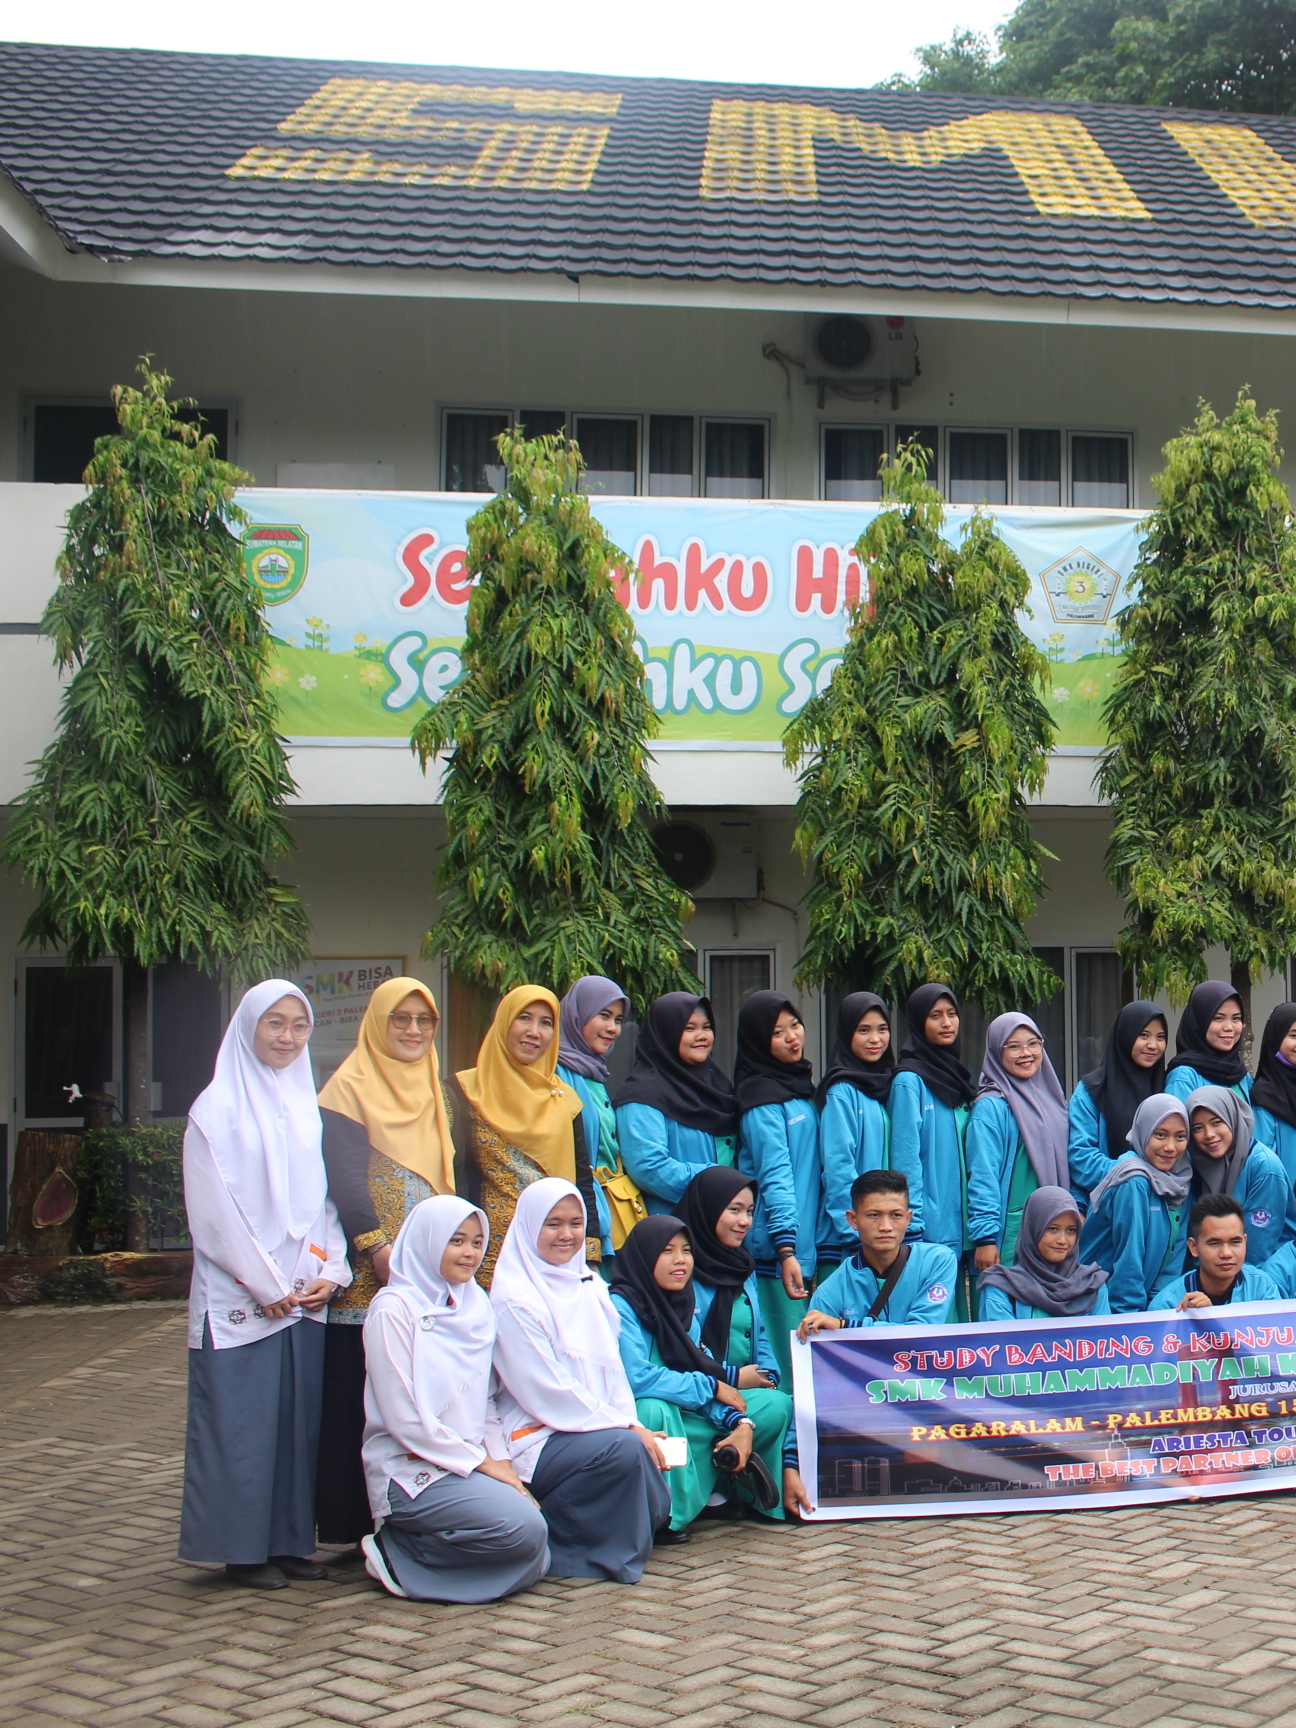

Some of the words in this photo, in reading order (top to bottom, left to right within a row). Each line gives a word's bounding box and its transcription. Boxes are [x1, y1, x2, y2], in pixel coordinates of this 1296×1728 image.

[888, 332, 903, 340] LG
[246, 540, 276, 549] SUMATERA
[277, 540, 302, 550] SELATAN
[399, 531, 769, 614] Sehku
[1058, 562, 1073, 576] SMK
[1076, 561, 1103, 578] NEGERI
[1076, 581, 1086, 594] 3
[385, 631, 762, 714] Sehku
[300, 970, 355, 1001] SMK
[358, 965, 394, 981] BISA
[358, 980, 383, 991] HEB
[315, 1010, 334, 1018] GERI
[340, 1015, 358, 1024] BISA
[894, 1345, 1000, 1372] STUDY
[1006, 1335, 1155, 1365] BANDING
[1162, 1334, 1181, 1353] &
[866, 1378, 947, 1404] SMK
[954, 1354, 1272, 1399] MUHAMMADIYAH
[910, 1416, 1084, 1442] PAGARALAM
[1106, 1400, 1268, 1430] PALEMBANG
[1149, 1431, 1248, 1454] ARIESTA
[1045, 1462, 1096, 1481] THE
[1099, 1458, 1158, 1479] BEST
[1161, 1449, 1272, 1474] PARTNER
